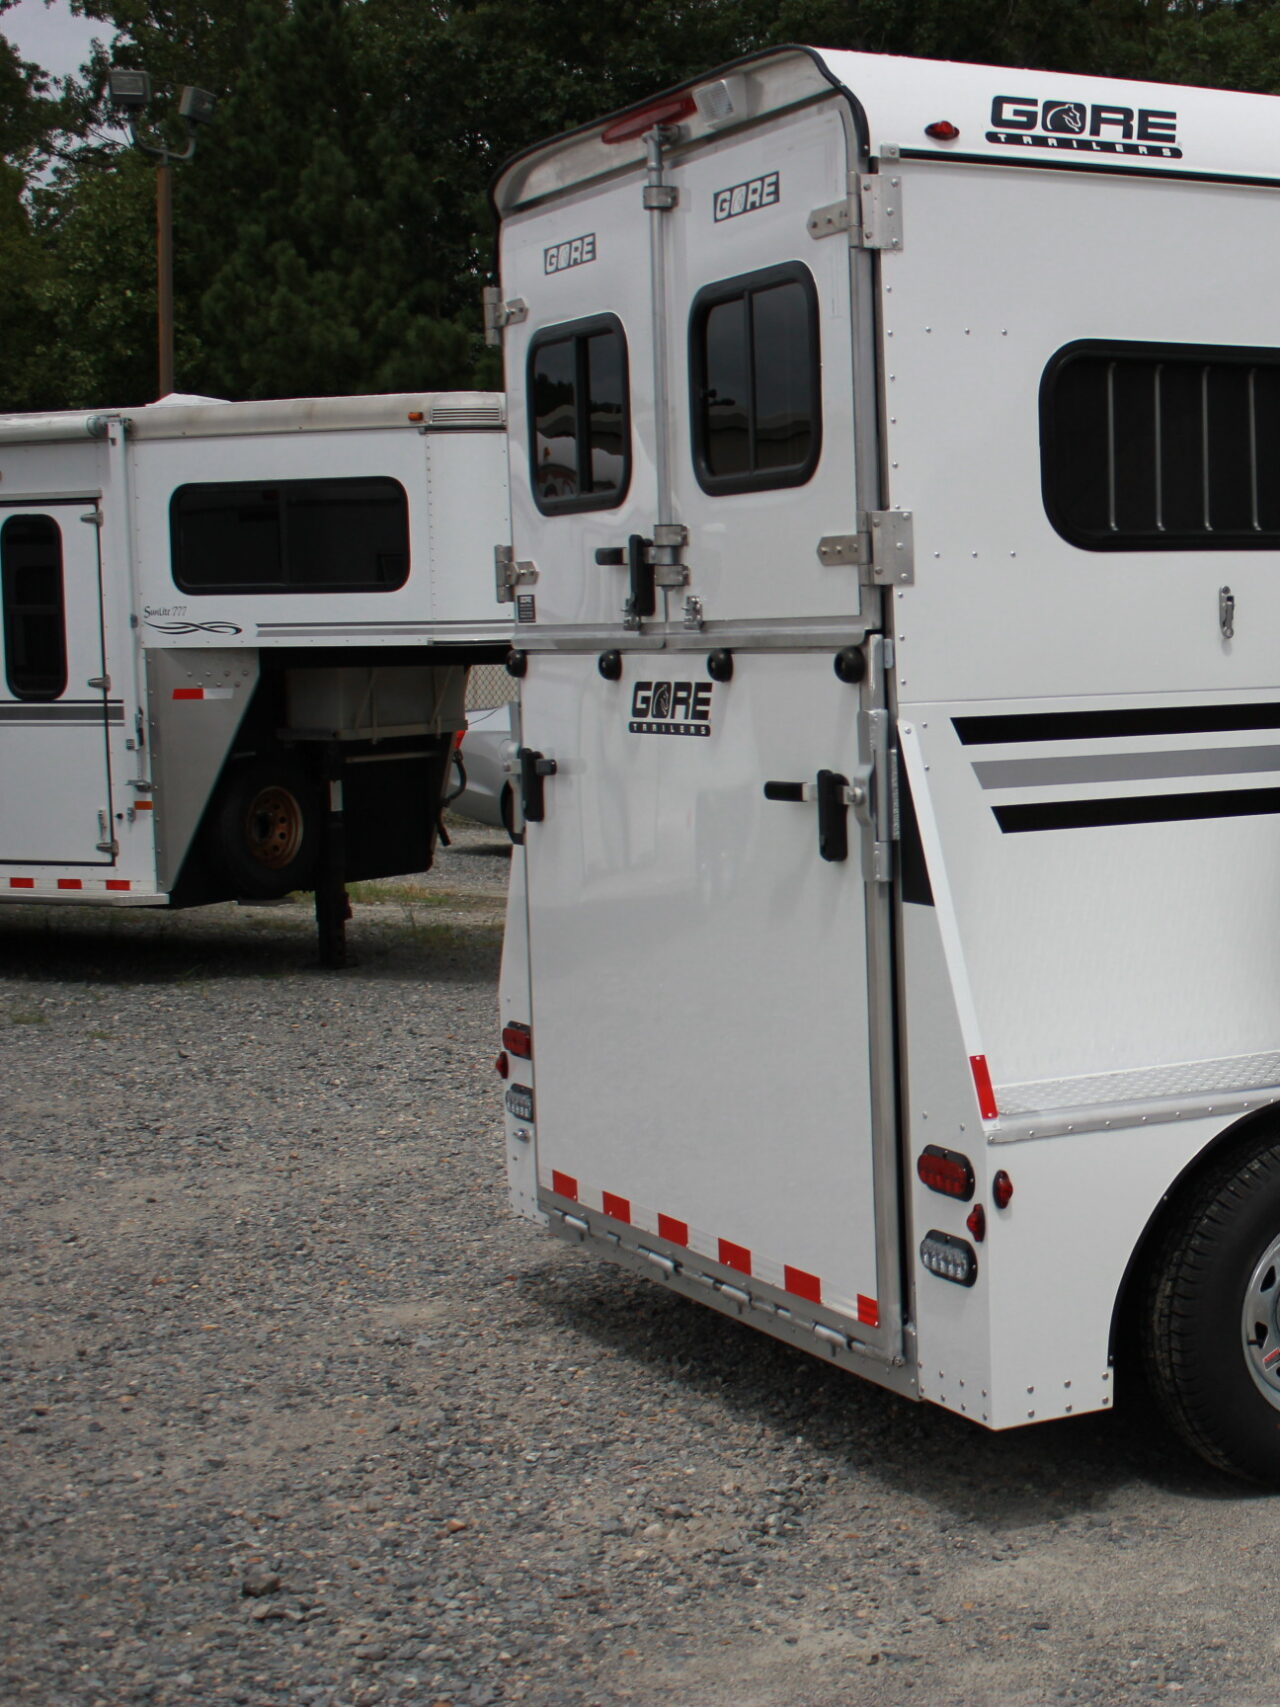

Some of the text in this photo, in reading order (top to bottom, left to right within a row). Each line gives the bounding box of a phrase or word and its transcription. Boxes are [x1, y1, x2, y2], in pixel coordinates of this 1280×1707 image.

[991, 95, 1177, 144] GORE
[997, 133, 1172, 157] TRAILERS
[715, 175, 778, 221] GORE
[545, 235, 596, 274] GORE
[632, 681, 713, 721] GORE
[632, 723, 706, 735] TRAILERS
